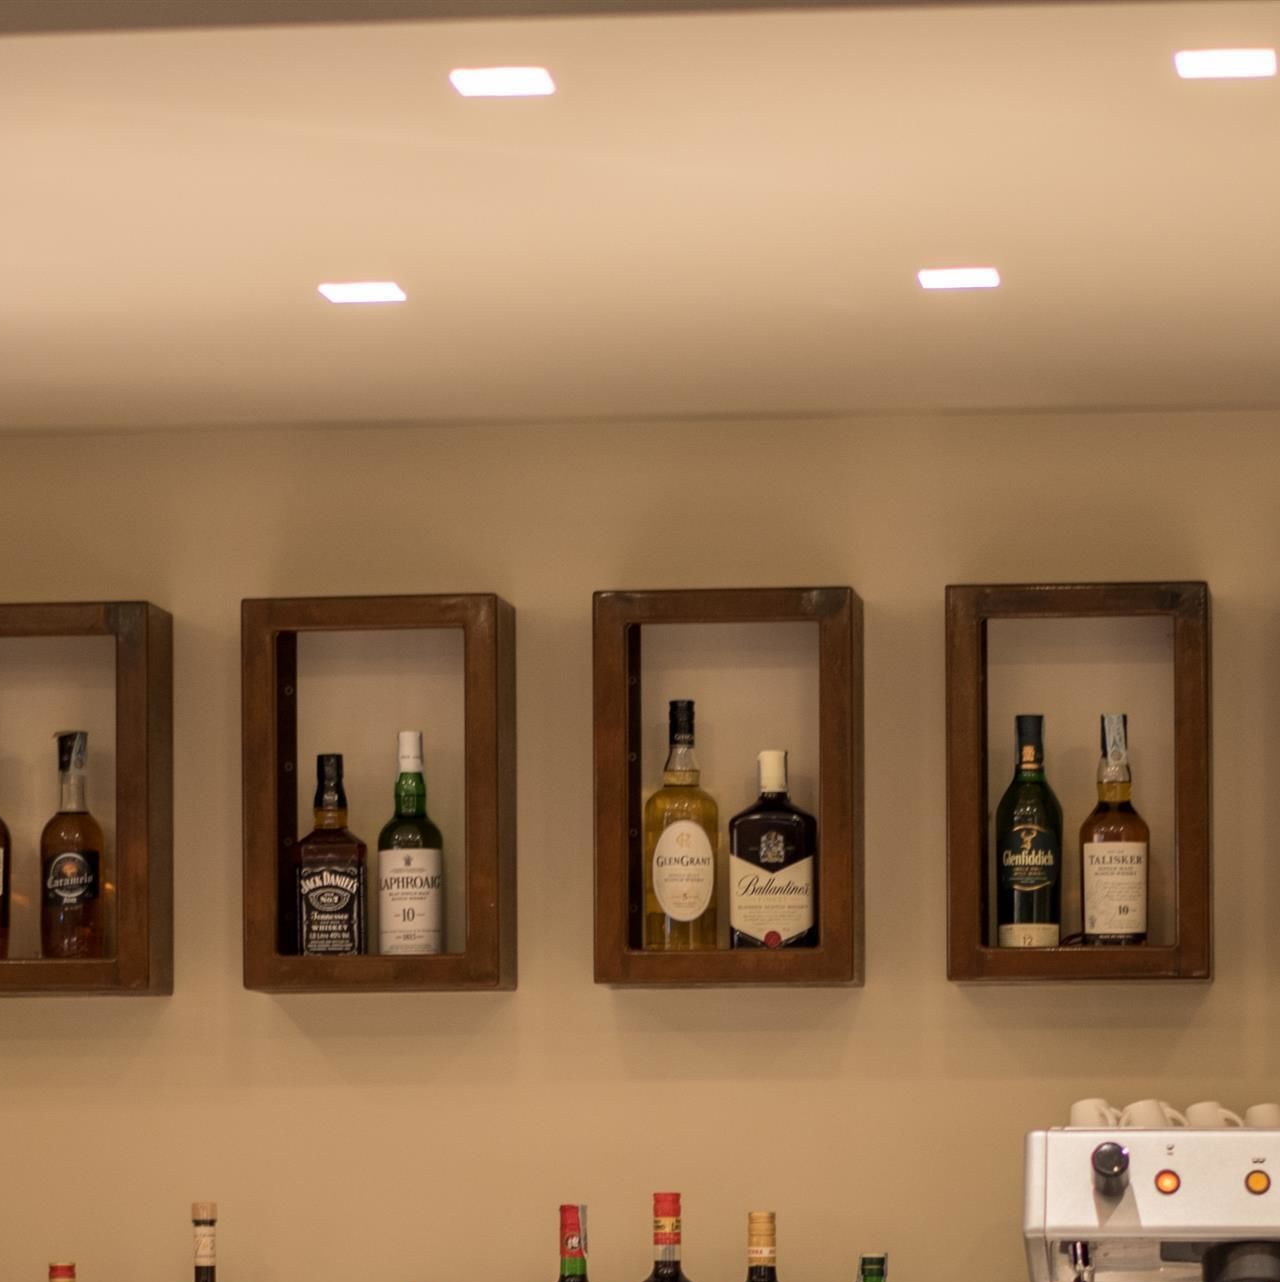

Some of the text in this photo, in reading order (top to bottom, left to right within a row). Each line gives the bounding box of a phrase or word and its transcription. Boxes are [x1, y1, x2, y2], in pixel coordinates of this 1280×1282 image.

[1003, 849, 1054, 866] Glenfiddich
[1088, 855, 1143, 865] TALISKER
[301, 876, 323, 895] JACK
[402, 907, 415, 922] 10
[1118, 904, 1129, 915] 10
